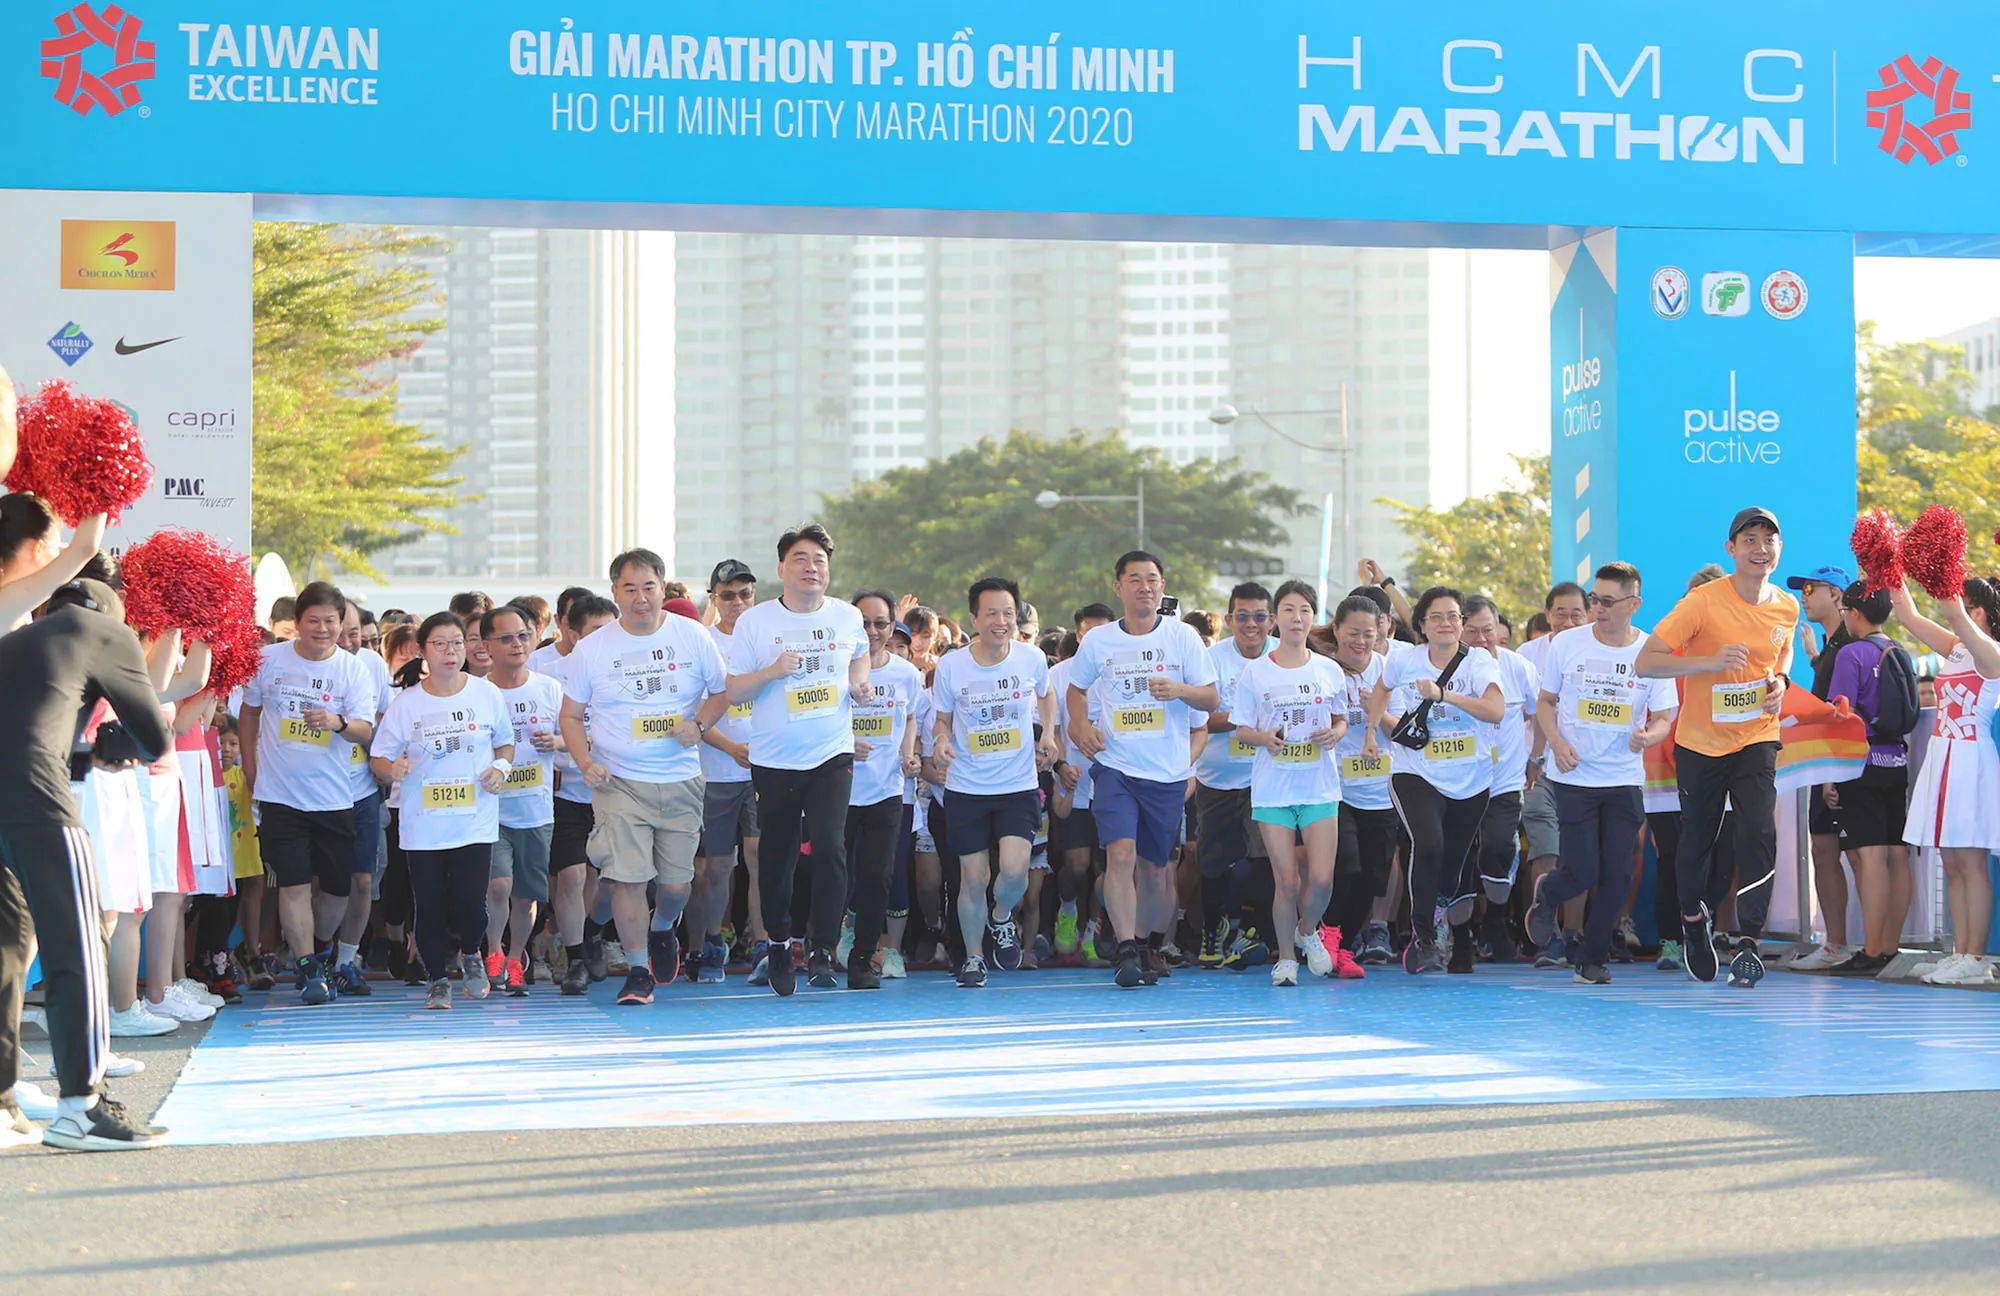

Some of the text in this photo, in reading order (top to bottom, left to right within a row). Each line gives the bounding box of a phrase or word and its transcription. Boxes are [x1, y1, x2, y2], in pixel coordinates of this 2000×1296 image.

[179, 23, 379, 70] TAIWAN
[509, 17, 1174, 93] GIẢI MARATHON TP. HỒ CHÍ MINH
[187, 74, 379, 104] EXCELLENCE
[551, 92, 1133, 146] HO CHI MINH CITY MARATHON 2020
[1298, 103, 1804, 165] MARATHON
[167, 408, 235, 430] capri
[1562, 397, 1601, 437] active
[1684, 434, 1781, 464] active
[164, 478, 205, 496] PMC
[199, 498, 236, 508] INVEST
[812, 629, 824, 641] 10
[652, 649, 664, 661] 10
[1142, 650, 1153, 661] 10
[1615, 663, 1627, 675] 10
[312, 678, 323, 690] 10
[636, 680, 643, 691] 5
[998, 678, 1009, 690] 10
[1124, 679, 1131, 690] 5
[1299, 684, 1310, 694] 10
[797, 688, 829, 705] 50005
[874, 686, 885, 697] 10
[1724, 691, 1757, 707] 50530
[289, 701, 296, 712] 5
[515, 702, 526, 713] 10
[981, 708, 988, 718] 5
[1588, 703, 1621, 718] 50926
[452, 711, 463, 722] 10
[1122, 712, 1154, 725] 50004
[1283, 711, 1289, 722] 5
[643, 718, 674, 733] 50009
[852, 719, 883, 731] 50001
[434, 739, 442, 751] 5
[978, 732, 1010, 748] 50003
[1432, 739, 1465, 754] 51216
[1282, 743, 1312, 757] 51219
[1352, 758, 1381, 772] 51082
[433, 787, 466, 801] 51214
